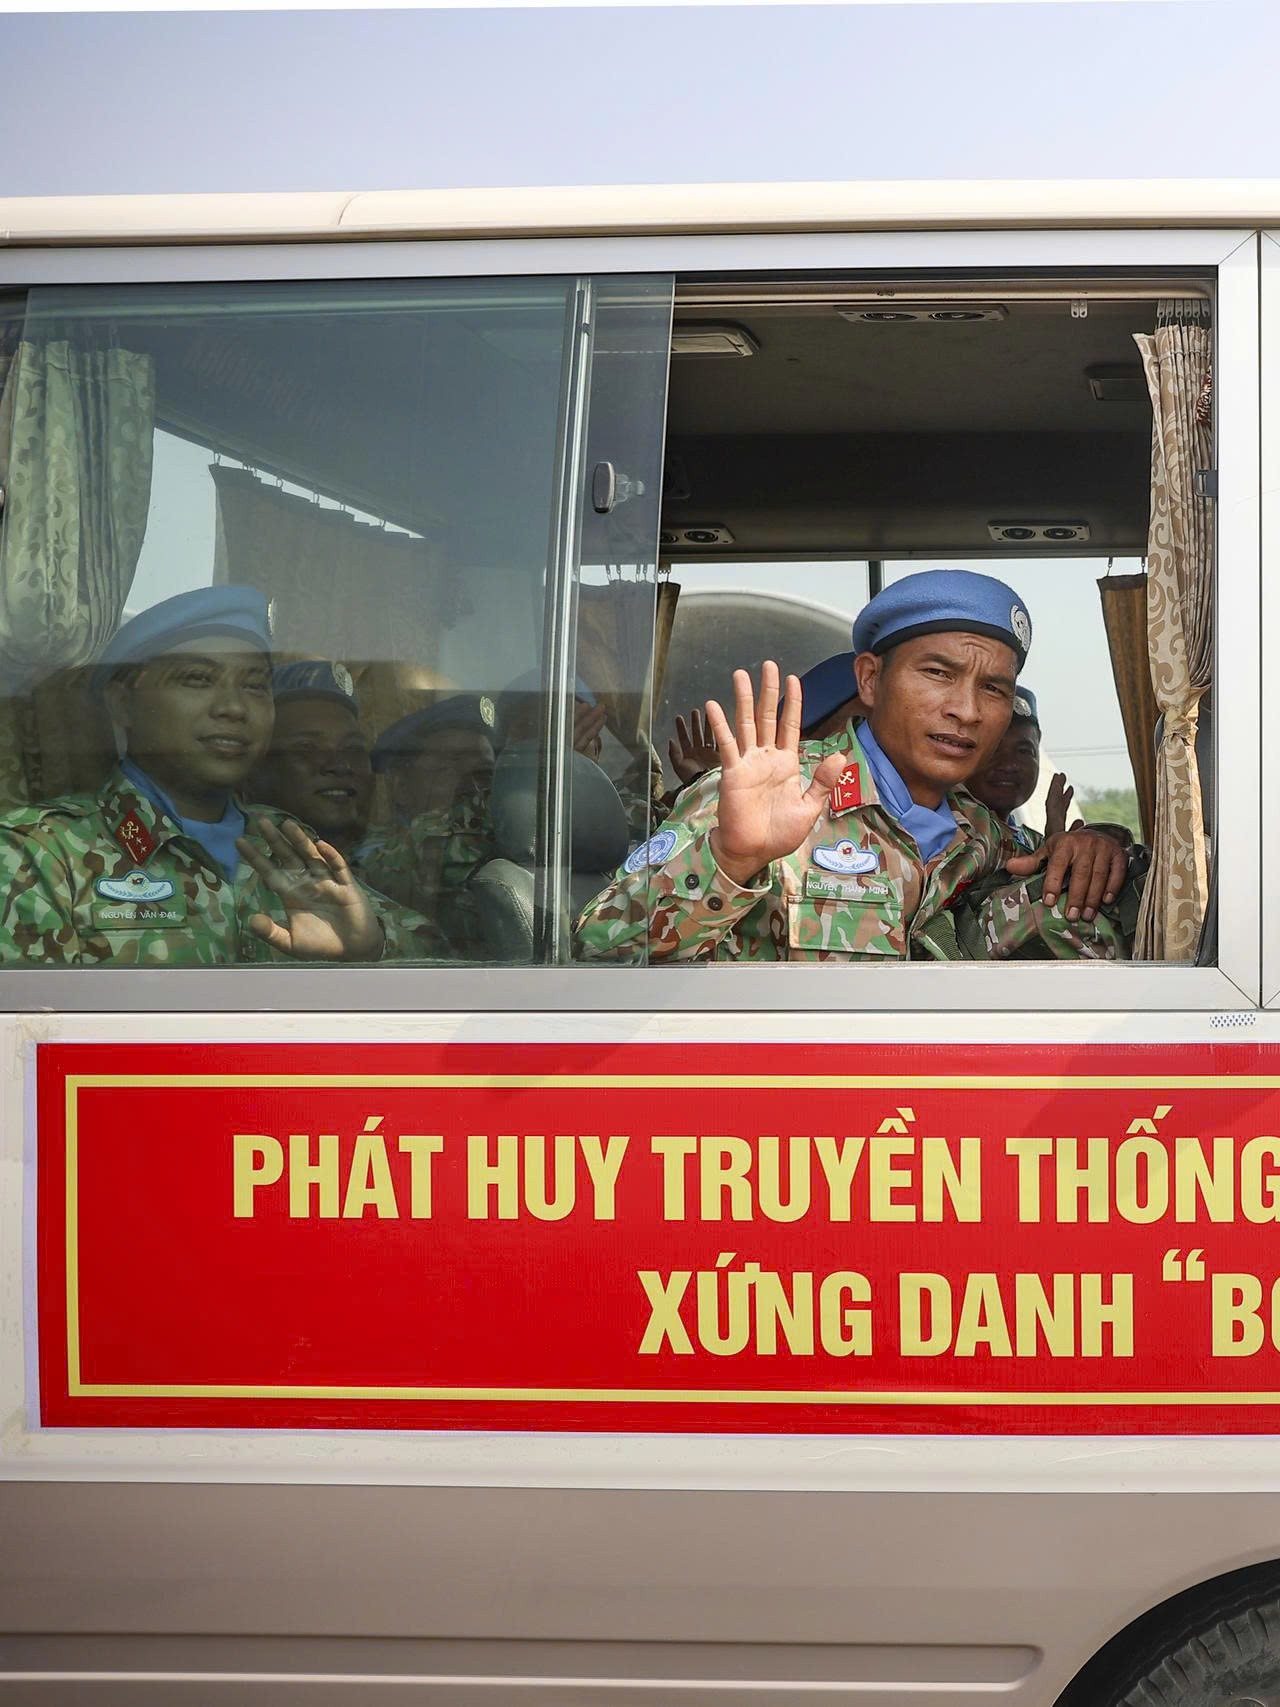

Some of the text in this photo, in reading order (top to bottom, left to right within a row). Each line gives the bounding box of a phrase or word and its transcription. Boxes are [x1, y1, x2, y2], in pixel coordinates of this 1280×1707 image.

[233, 1116, 444, 1219] PHÁT
[467, 1135, 630, 1221] HUY
[651, 1107, 982, 1223] TRUYỀN
[637, 1252, 873, 1357] XỨNG
[899, 1272, 1134, 1357] DANH
